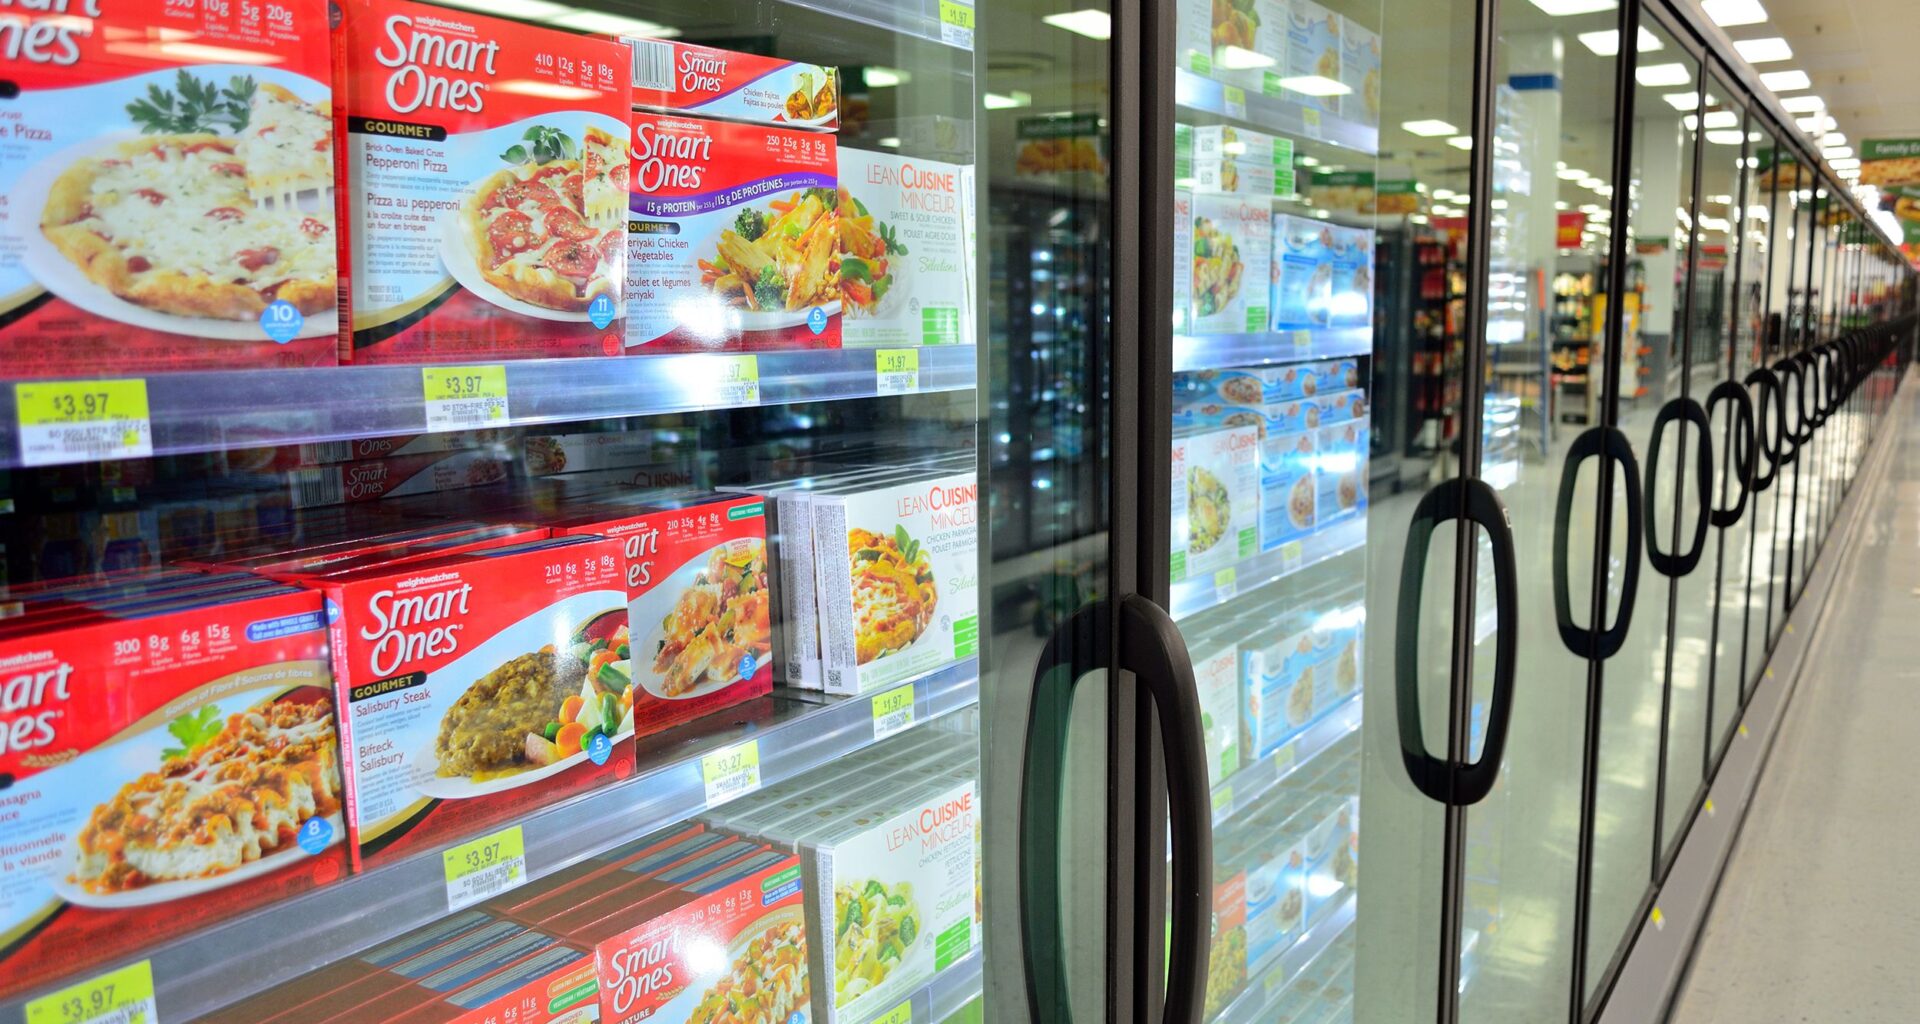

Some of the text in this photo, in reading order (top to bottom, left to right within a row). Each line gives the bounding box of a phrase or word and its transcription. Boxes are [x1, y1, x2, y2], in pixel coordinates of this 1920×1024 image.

[242, 1, 260, 21] 5g
[266, 4, 294, 26] 20g
[0, 14, 80, 65] nes
[375, 15, 500, 75] Smart
[535, 53, 613, 80] 410 12g 5g 18g
[678, 50, 727, 76] Smart
[385, 65, 484, 113] Ones
[682, 71, 721, 92] Ones
[743, 87, 764, 98] Chicken
[743, 97, 760, 108] Fajitas
[767, 100, 784, 110] poulet
[15, 124, 52, 141] Pizza
[365, 121, 433, 138] GOURMET
[365, 142, 384, 151] Brick
[405, 146, 425, 156] Baked
[426, 148, 444, 158] Crust
[631, 123, 712, 161] Smart
[766, 135, 780, 146] 250
[801, 139, 811, 152] 3g
[815, 140, 826, 153] 15g
[1875, 143, 1909, 156] Family
[366, 153, 448, 173] Pepperoni Pizza
[638, 158, 701, 193] Ones
[867, 163, 954, 193] LEAN CUISINE
[367, 192, 461, 213] Pizza au pepperoni
[646, 201, 656, 211] 15
[656, 204, 662, 215] g
[663, 201, 696, 213] PROTEIN
[725, 196, 731, 206] g
[731, 191, 743, 201] DE
[743, 177, 784, 197] PROTÉINES
[901, 192, 956, 213] MINCEUR
[378, 221, 391, 231] four
[403, 222, 426, 233] briques
[421, 214, 435, 222] dans
[628, 222, 670, 233] OURMET
[890, 210, 909, 221] SWEET
[917, 213, 931, 222] SOUR
[932, 214, 956, 225] CHICKEN
[627, 237, 689, 251] eriyaki Chicken
[903, 229, 923, 239] POULET
[630, 250, 674, 262] Vegetables
[652, 278, 661, 287] et
[661, 277, 691, 289] légumes
[270, 305, 292, 323] 10
[597, 298, 608, 312] 11
[813, 310, 821, 321] 6
[887, 355, 906, 370] $1.97
[446, 376, 482, 393] $3.97
[53, 393, 109, 416] $3.97
[360, 439, 392, 456] Ones
[347, 467, 388, 486] Smart
[350, 481, 385, 498] Ones
[896, 495, 929, 518] LEAN
[667, 519, 679, 531] 210
[698, 515, 706, 526] 4g
[710, 513, 719, 524] 8g
[931, 508, 977, 532] MINCEU
[624, 528, 659, 559] art
[926, 526, 977, 545] CHICKEN PARMIGIA
[932, 537, 977, 554] POULET PARMIGIA
[545, 555, 615, 577] 210 6g 5g 18g
[627, 562, 651, 588] es
[360, 583, 473, 641] Smart
[113, 623, 231, 657] 300 8g 6g 15g
[370, 624, 459, 677] Ones
[744, 655, 751, 667] 5
[0, 662, 74, 712] art
[164, 669, 313, 717] Source of Fibre Source de fibres
[354, 675, 414, 699] GOURMET
[356, 688, 431, 718] Salisbury Steak
[883, 694, 903, 712] $1.97
[0, 710, 56, 751] es
[359, 739, 394, 759] Bifteck
[596, 738, 604, 750] 5
[360, 751, 405, 773] Salisbury
[718, 753, 742, 772] $3.27
[0, 789, 42, 807] asagna
[308, 820, 319, 836] 8
[885, 792, 972, 852] LEAN CUISINE
[921, 813, 973, 854] MINCEUR
[3, 847, 63, 872] la viande
[465, 842, 500, 867] $3.97
[918, 850, 942, 868] CHICKEN
[708, 903, 721, 916] 10g
[725, 897, 736, 907] 6g
[739, 889, 752, 901] 13g
[606, 926, 682, 988] Smart
[613, 962, 674, 1015] Ones
[62, 984, 116, 1020] $3.97
[505, 997, 536, 1018] 6g 11g
